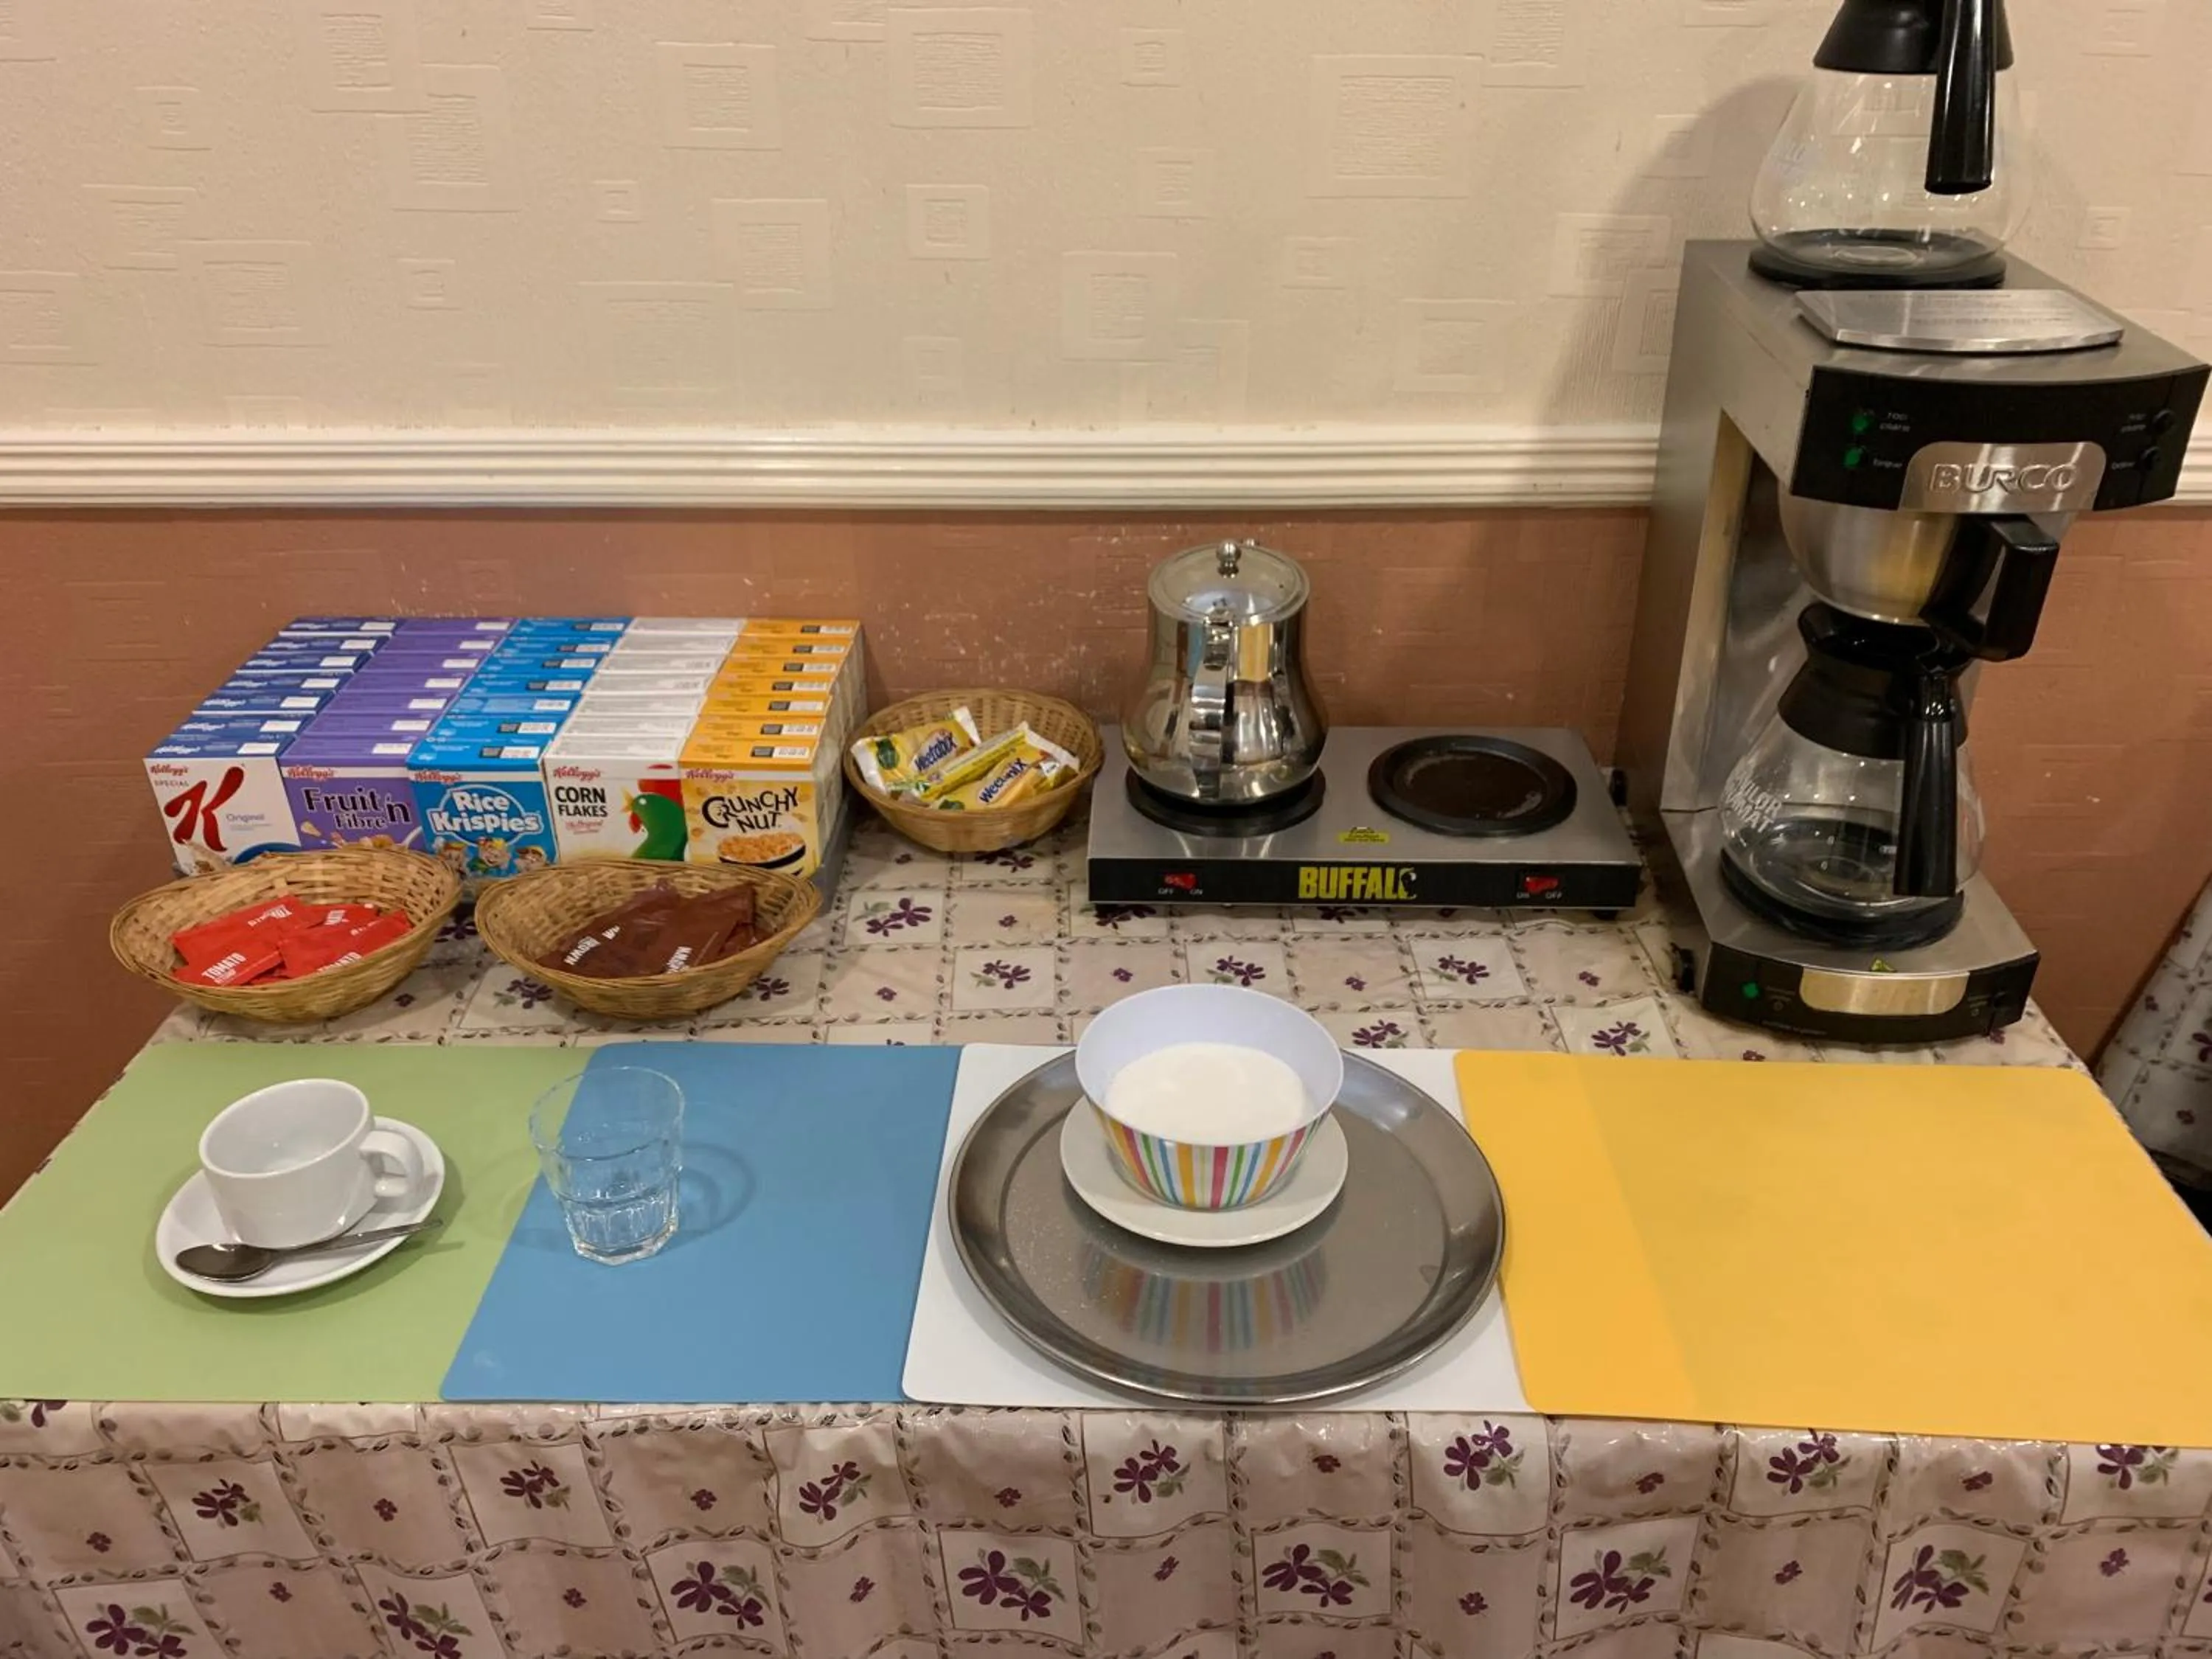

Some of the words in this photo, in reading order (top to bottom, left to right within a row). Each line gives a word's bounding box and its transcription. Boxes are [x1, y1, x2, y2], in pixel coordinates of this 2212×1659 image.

[1930, 464, 2076, 494] BURCO
[150, 764, 189, 776] Kellogg's
[287, 765, 334, 782] Kellogg's
[415, 770, 461, 785] Kellogg's
[554, 765, 602, 782] Kellogg's
[686, 768, 735, 783] Kellogg's
[302, 785, 382, 812] Fruit
[452, 790, 510, 813] Rice
[555, 786, 606, 804] CORN
[164, 766, 245, 852] K
[558, 804, 608, 818] FLAKES
[702, 786, 799, 828] CRUNCHY
[333, 813, 389, 830] Fibre
[431, 811, 540, 833] Krispies
[737, 811, 782, 833] NUT
[201, 953, 246, 980] TOMATO
